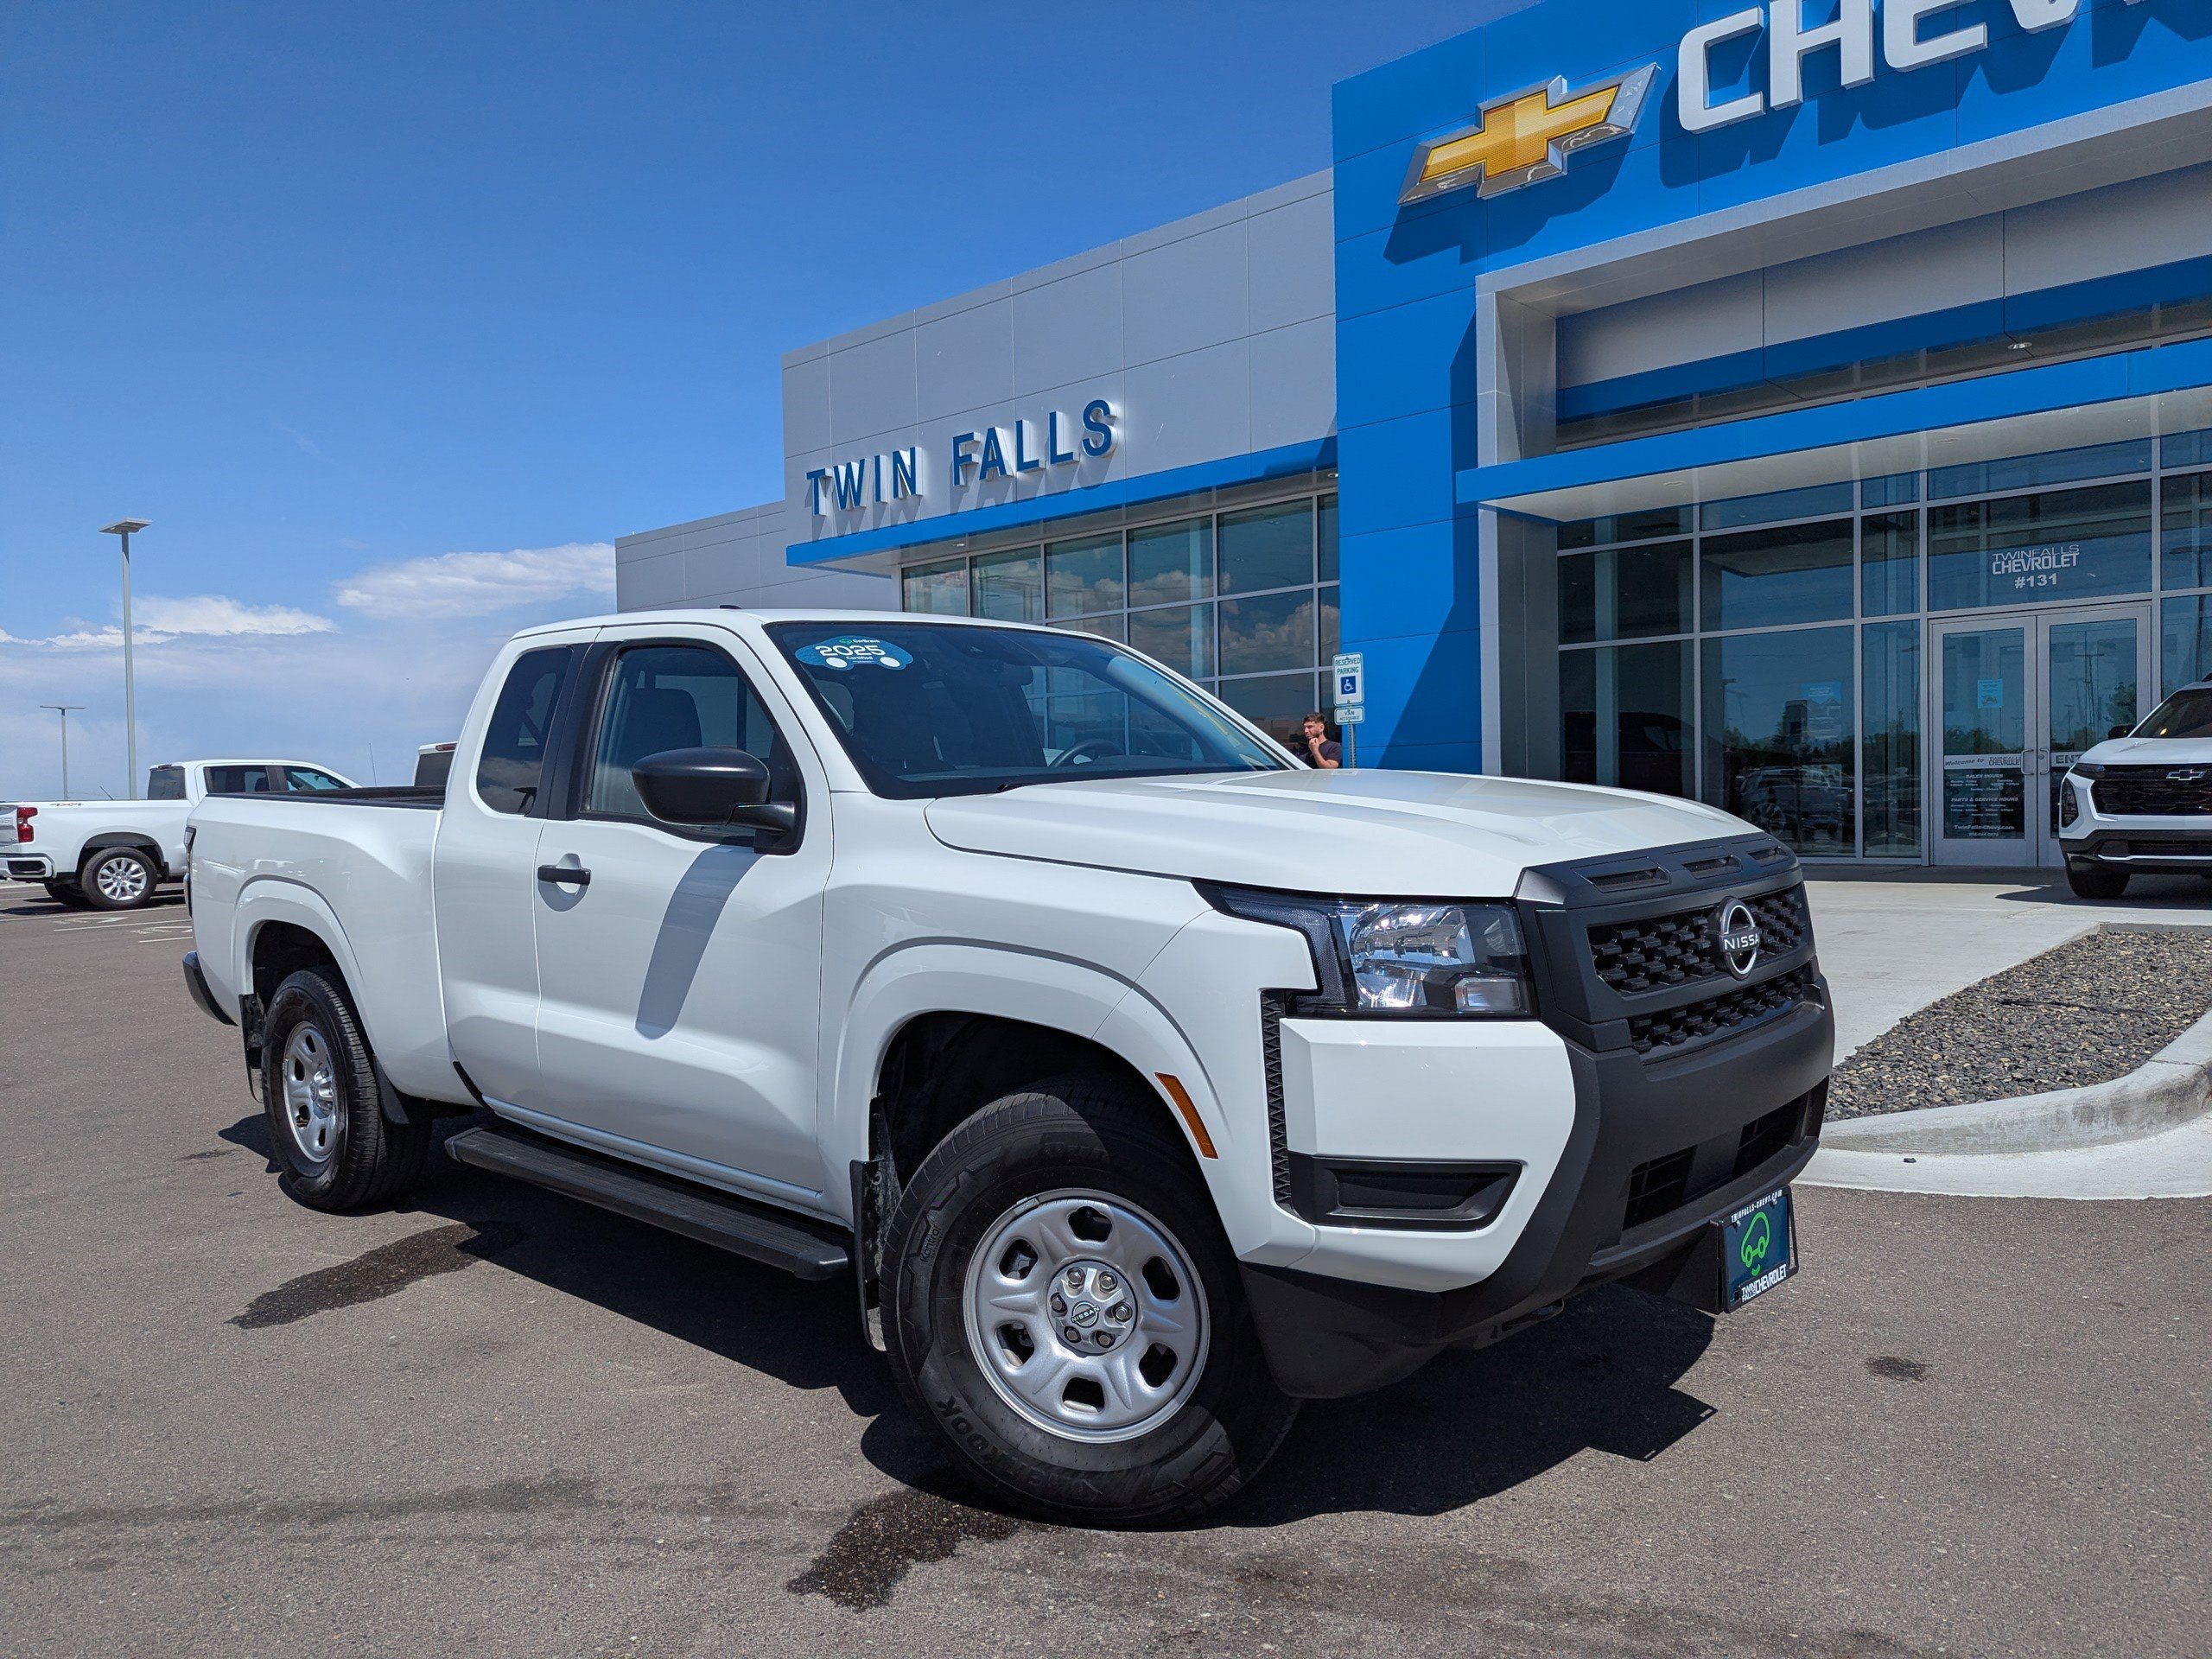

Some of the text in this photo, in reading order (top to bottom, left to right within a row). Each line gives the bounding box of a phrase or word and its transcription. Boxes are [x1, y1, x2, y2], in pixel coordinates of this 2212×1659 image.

[1678, 0, 2078, 133] CHE
[806, 399, 1118, 517] TWIN FALLS
[1993, 553, 2079, 575] CHEVROLET
[2015, 573, 2057, 588] #131
[815, 645, 886, 657] 2025
[1335, 658, 1360, 666] RESERVED
[1337, 666, 1359, 675] PARKING
[1724, 933, 1759, 950] NISSA
[1754, 1263, 1787, 1294] CHEVROLET
[1071, 1305, 1100, 1323] NISSAN
